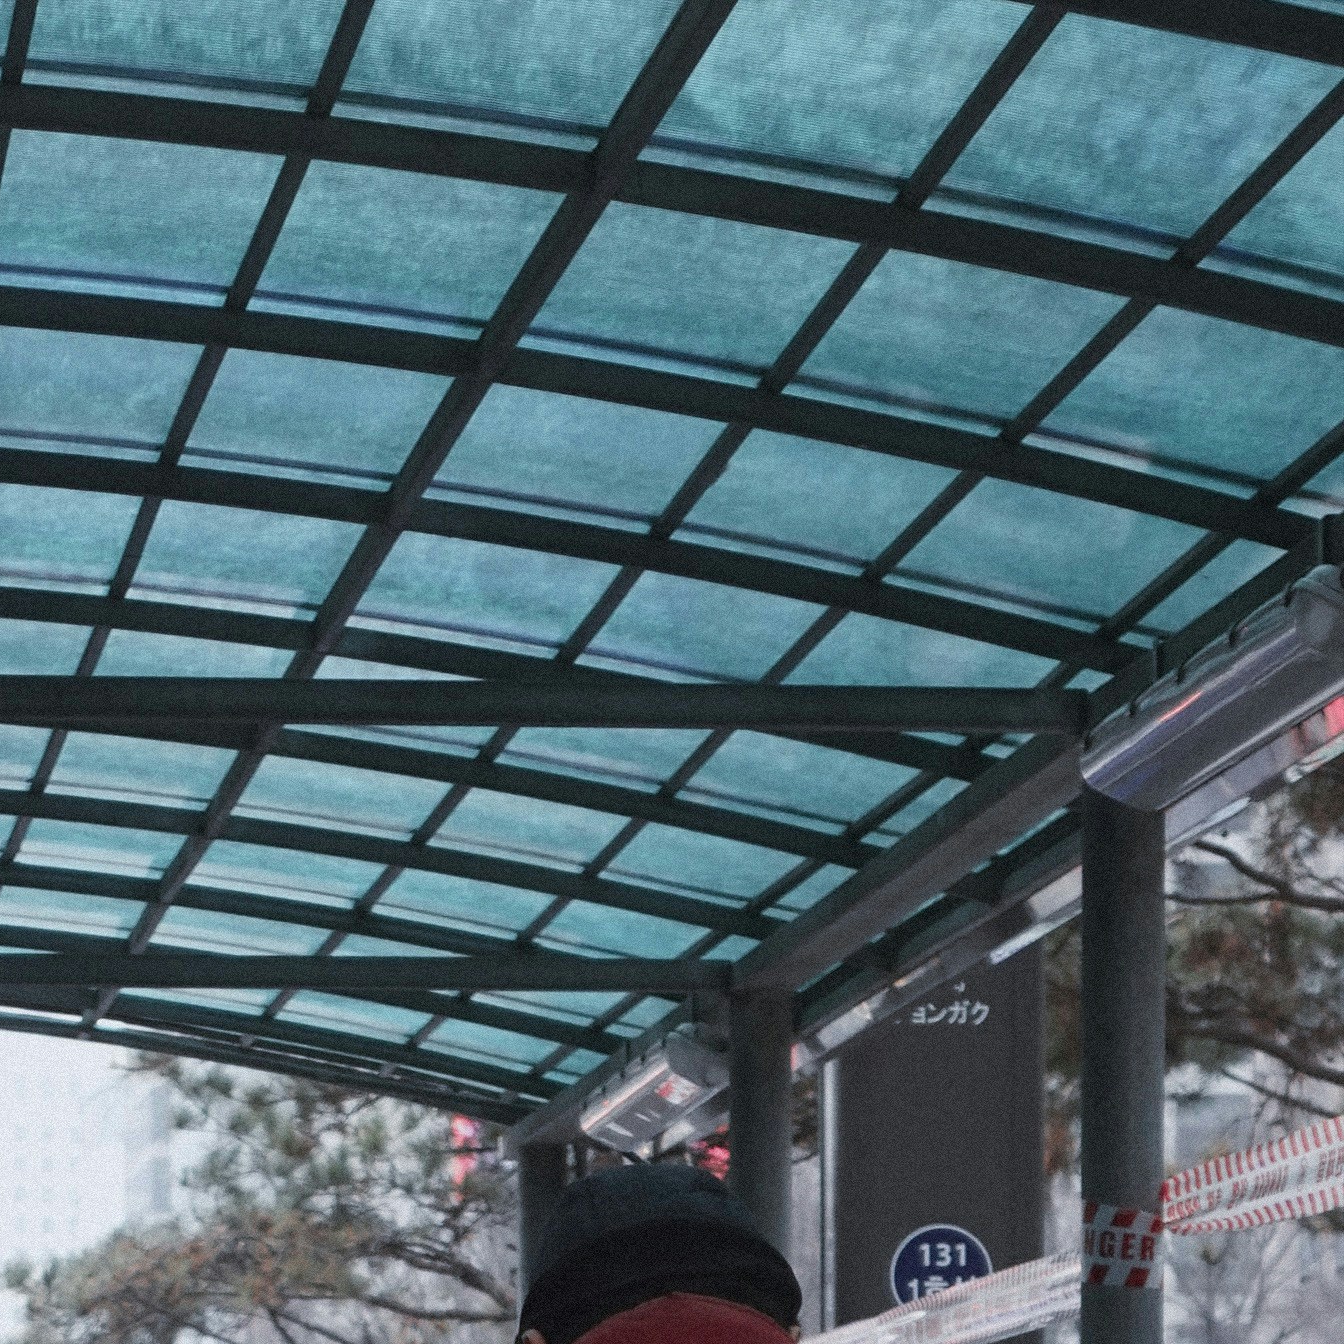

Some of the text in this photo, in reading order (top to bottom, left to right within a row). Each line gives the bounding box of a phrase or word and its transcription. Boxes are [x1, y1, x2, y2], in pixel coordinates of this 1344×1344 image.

[895, 1000, 990, 1026] ョンガク
[919, 1243, 967, 1267] 131
